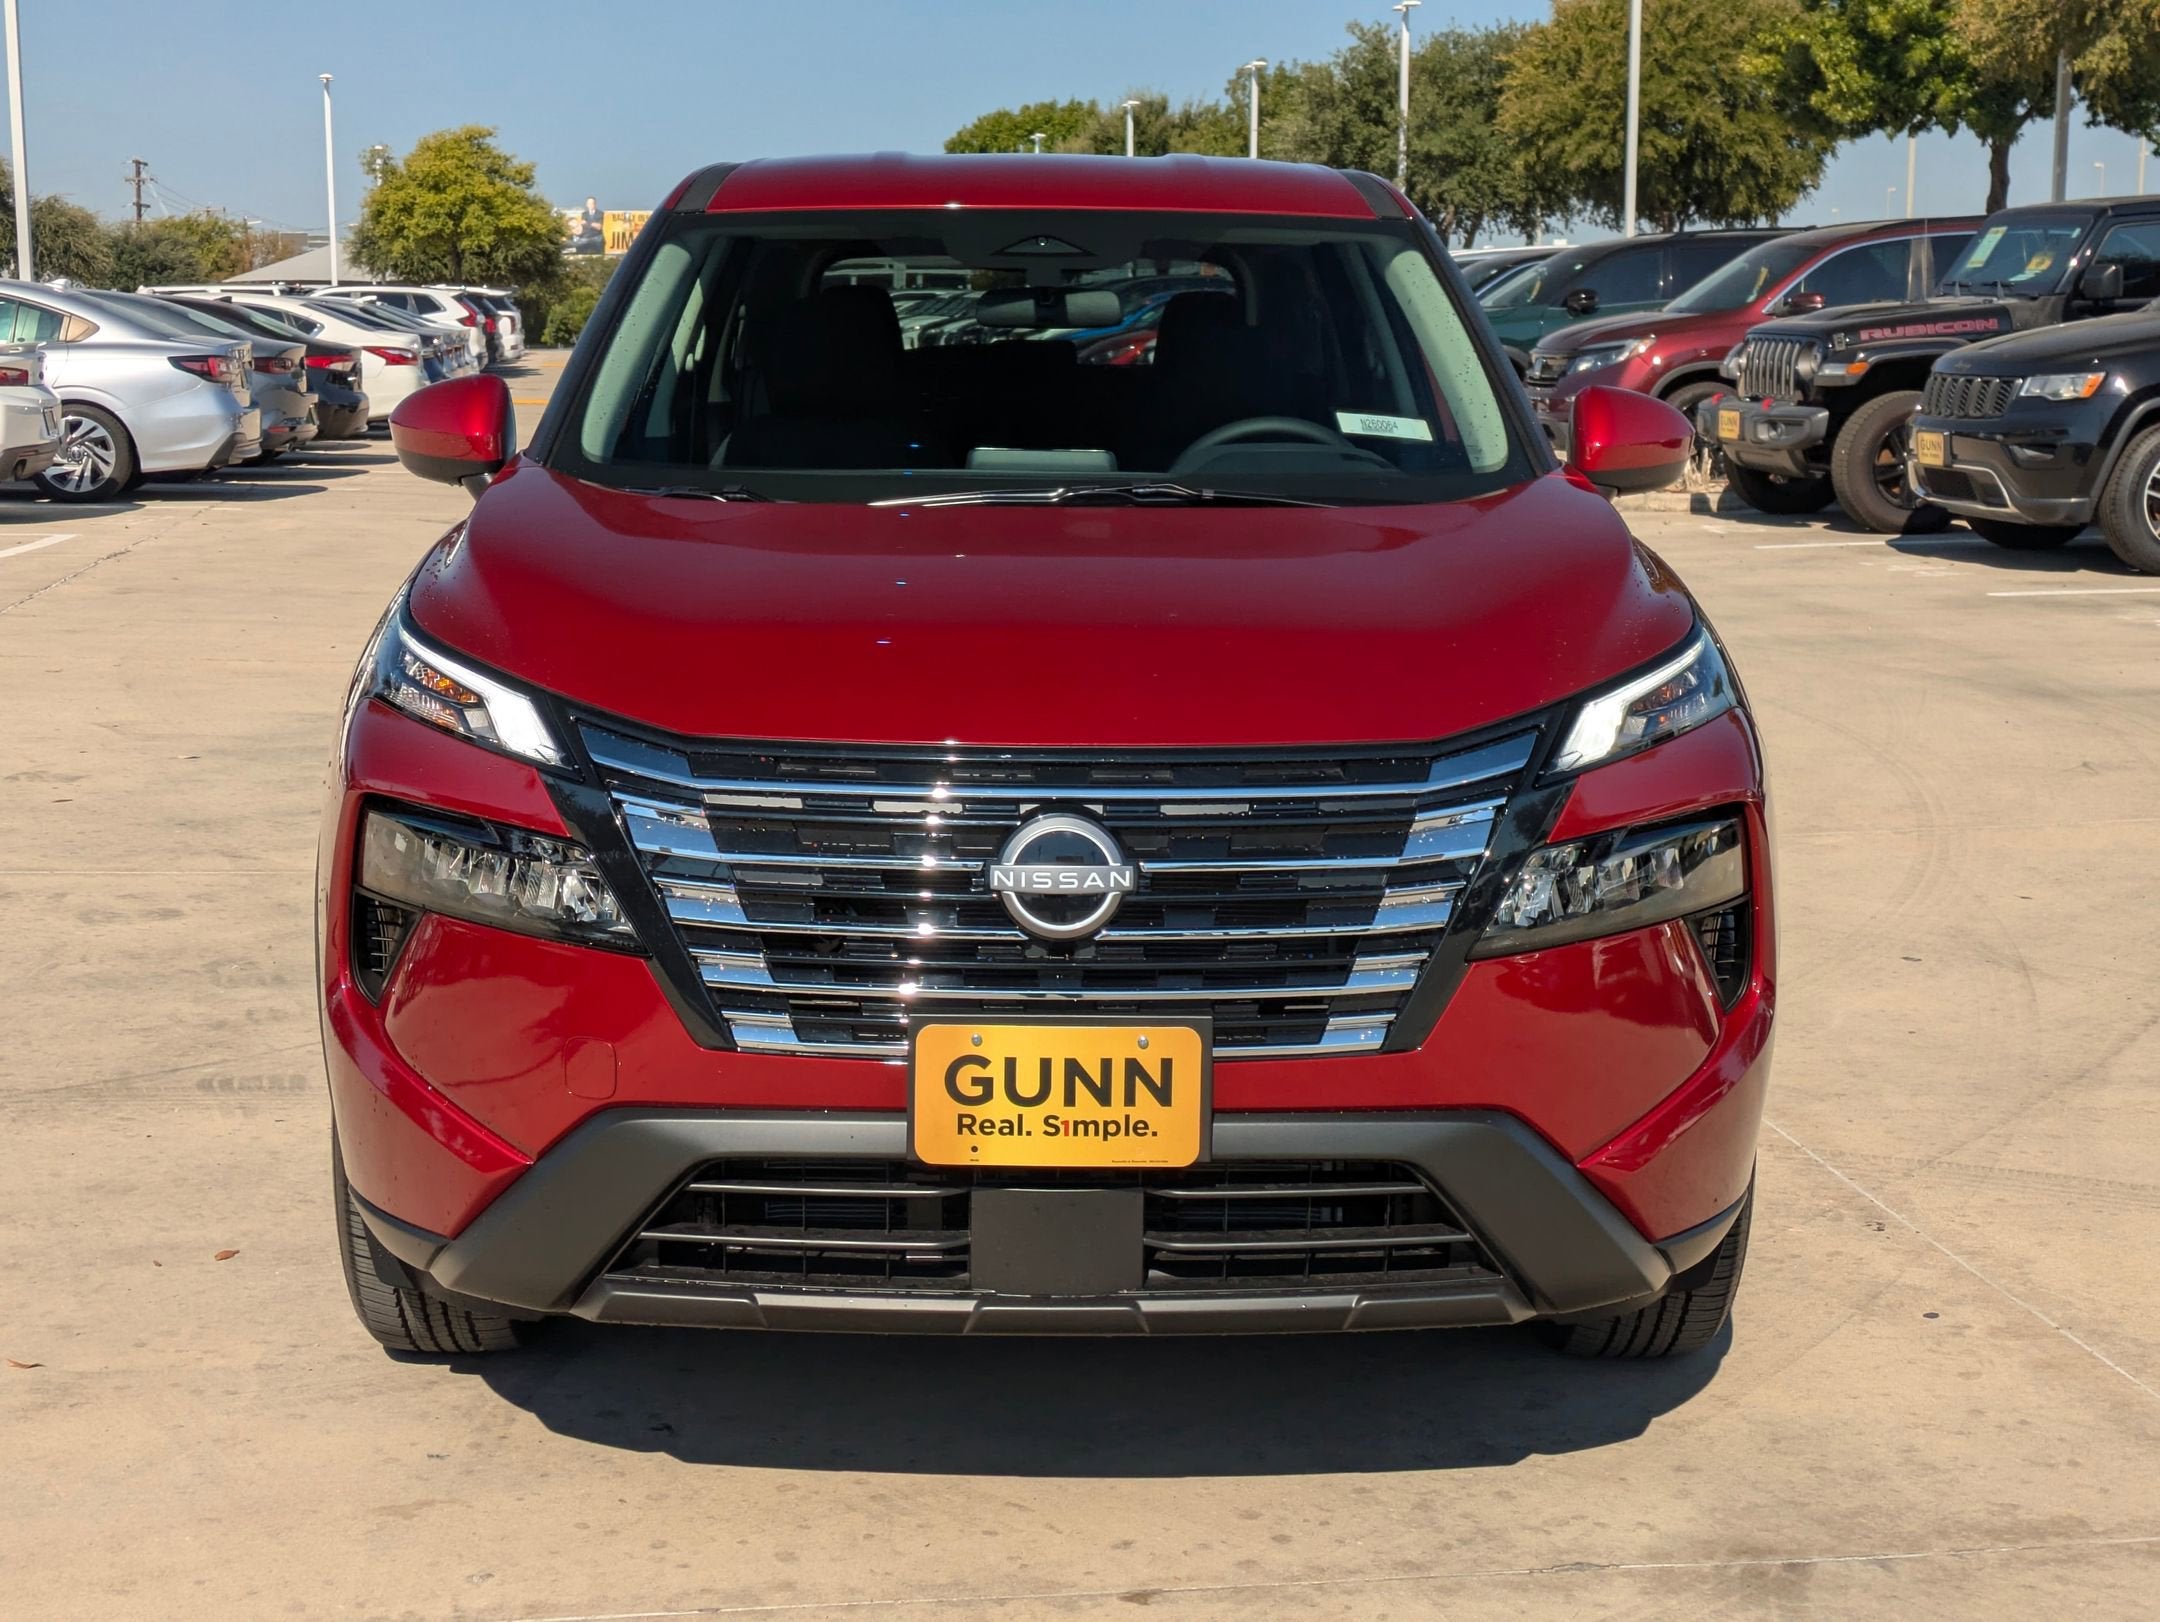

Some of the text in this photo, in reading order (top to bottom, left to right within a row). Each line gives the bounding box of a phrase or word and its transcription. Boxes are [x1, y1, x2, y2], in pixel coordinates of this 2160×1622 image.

[1859, 318, 1999, 341] RUBICON
[993, 870, 1131, 889] NISSAN
[944, 1054, 1173, 1107] GUNN
[957, 1113, 1032, 1136] Real.
